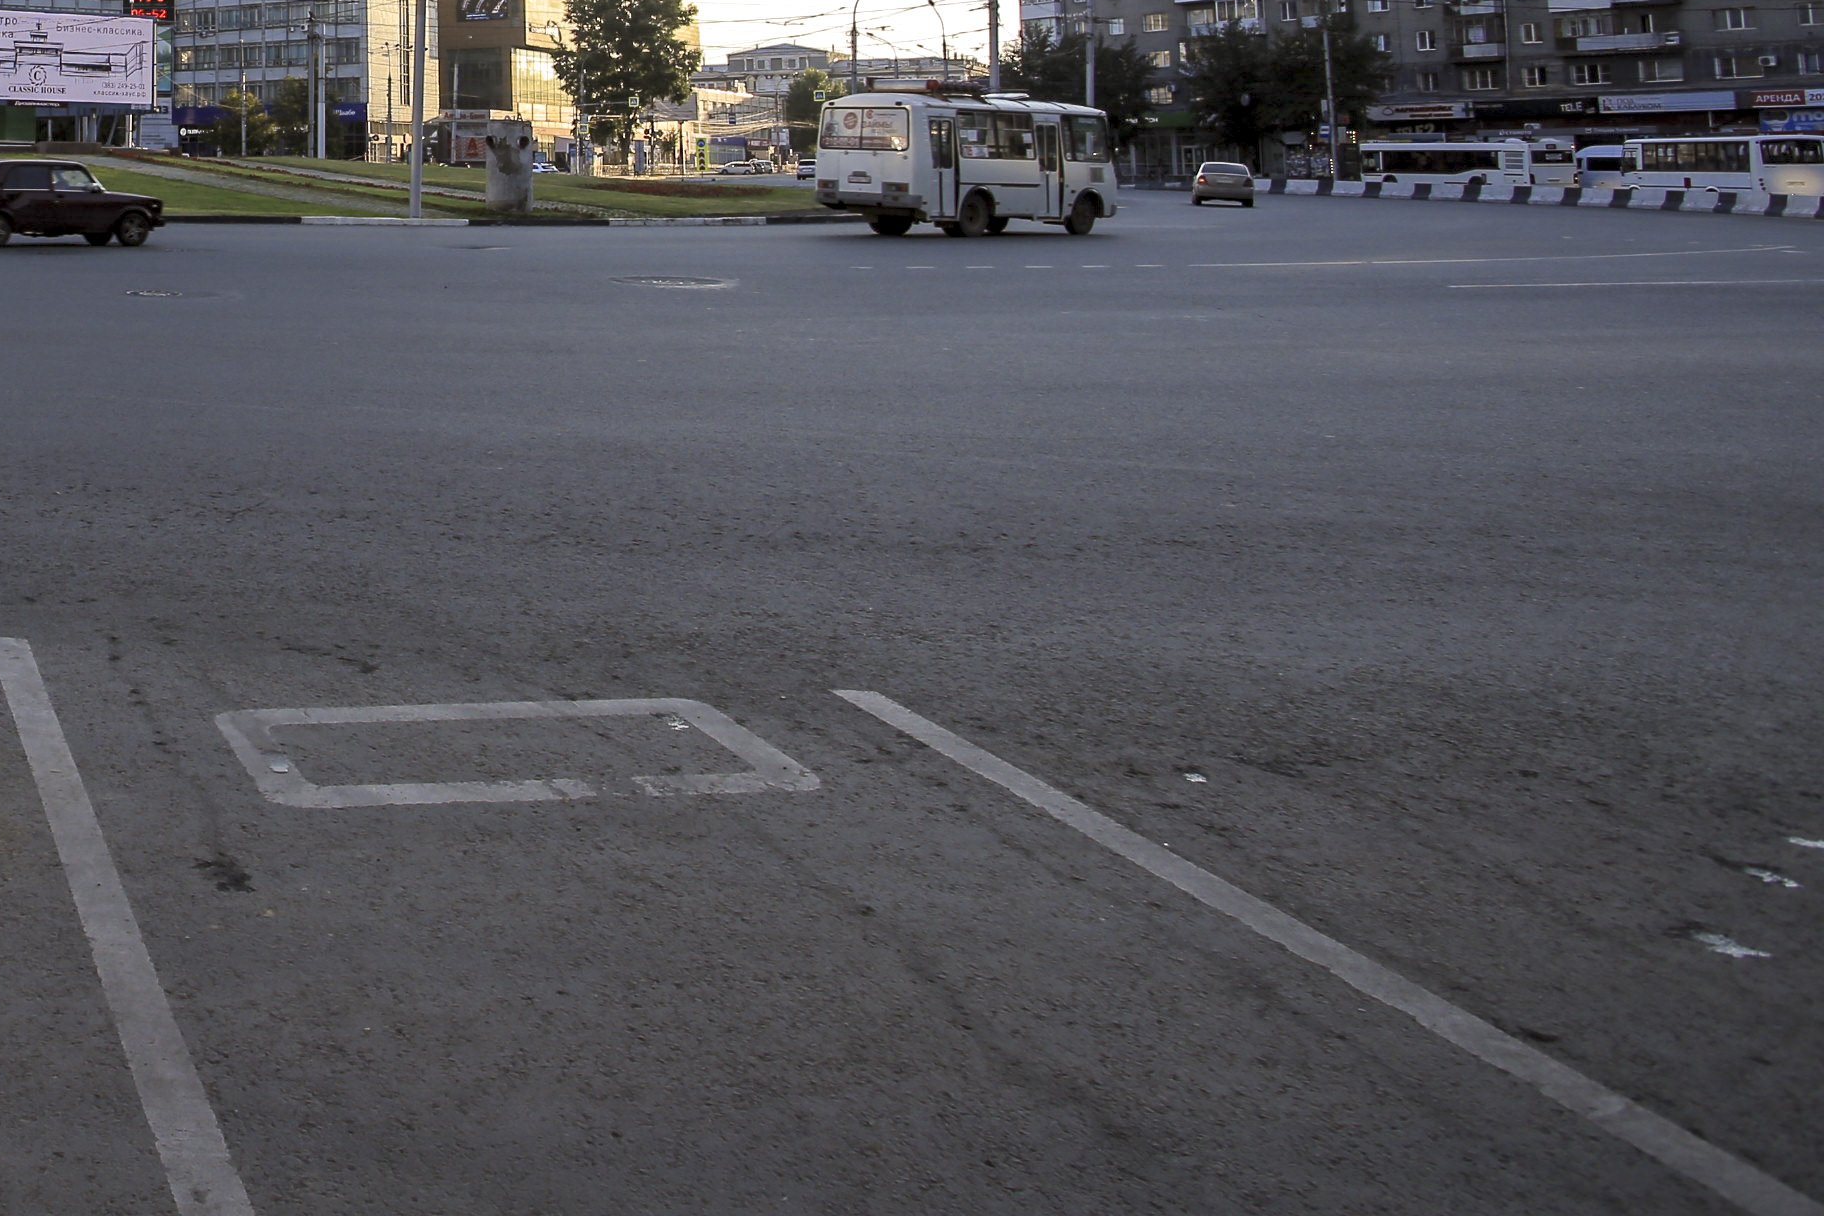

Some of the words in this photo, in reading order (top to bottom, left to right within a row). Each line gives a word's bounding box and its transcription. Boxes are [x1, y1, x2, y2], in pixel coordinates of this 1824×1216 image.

[56, 23, 145, 36] Бизнес-классика.
[8, 85, 40, 94] CLASSIC
[41, 86, 67, 95] HOUSE
[1755, 94, 1801, 103] АРЕНДА
[1809, 93, 1824, 102] 20
